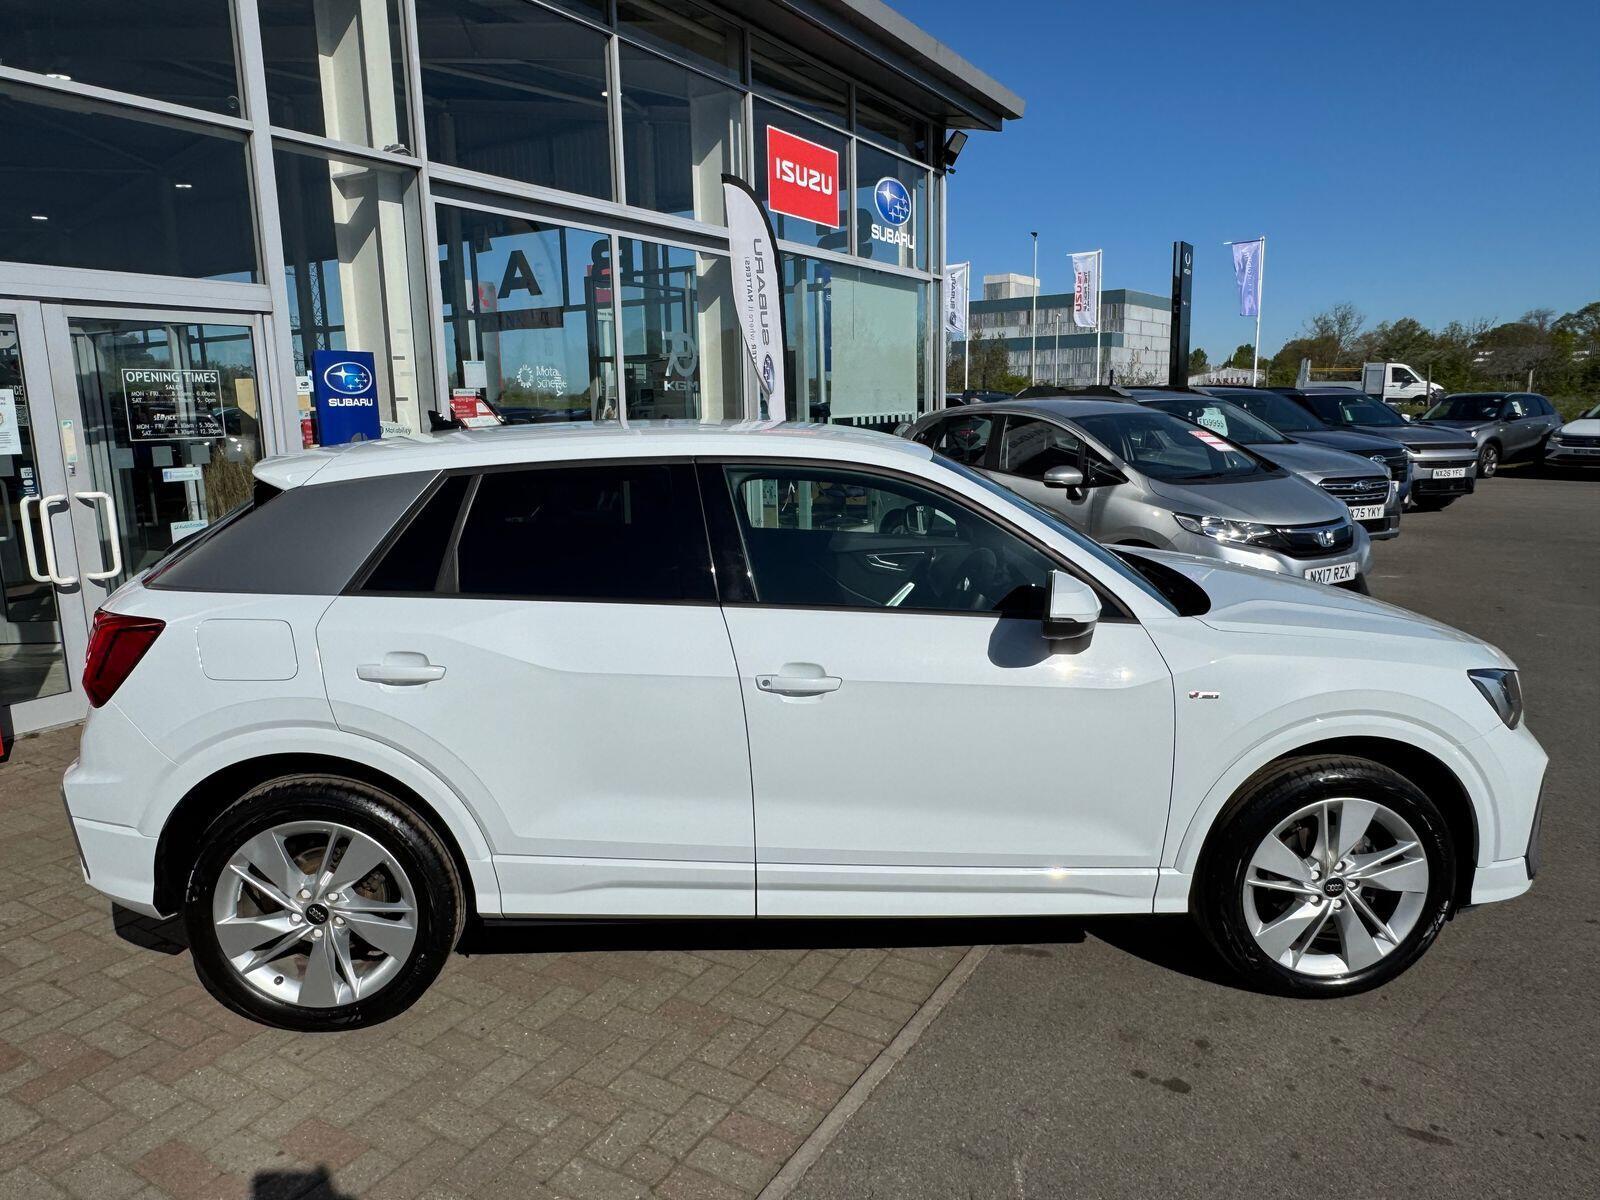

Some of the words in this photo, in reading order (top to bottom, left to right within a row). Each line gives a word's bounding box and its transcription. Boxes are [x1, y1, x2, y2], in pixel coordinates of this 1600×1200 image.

[776, 157, 832, 195] ISUZU
[871, 223, 915, 249] SUBARU
[126, 371, 180, 383] OPENING
[182, 372, 217, 383] TIMES
[664, 380, 699, 391] KGM
[328, 398, 373, 407] SUBARU
[385, 427, 412, 435] Motability
[1350, 507, 1366, 518] X75
[1367, 506, 1381, 517] YKY
[1310, 568, 1332, 583] NX17
[1333, 565, 1351, 580] RZK
